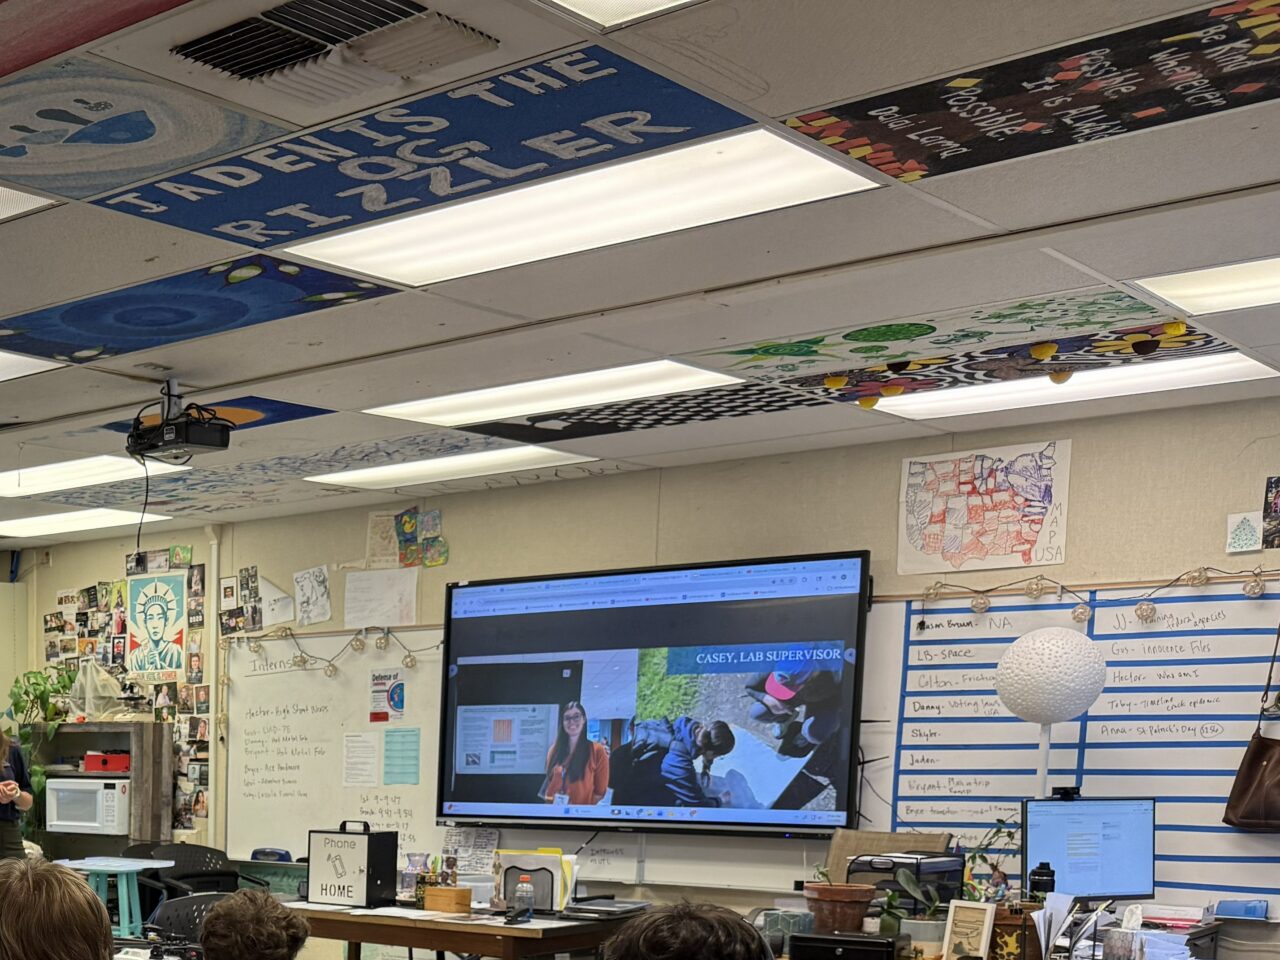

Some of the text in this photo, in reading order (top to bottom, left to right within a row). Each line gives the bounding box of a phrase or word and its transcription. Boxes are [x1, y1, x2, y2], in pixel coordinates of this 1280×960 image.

[447, 51, 618, 108] THE
[867, 105, 972, 159] Dalai Lama
[338, 136, 493, 181] OG
[212, 110, 694, 243] RIZZLER
[1035, 545, 1063, 561] USA
[989, 616, 1013, 630] NA
[740, 652, 764, 662] LAB
[765, 649, 841, 661] SUPERVISOR
[323, 837, 357, 850] Phone
[320, 883, 355, 899] HOME
